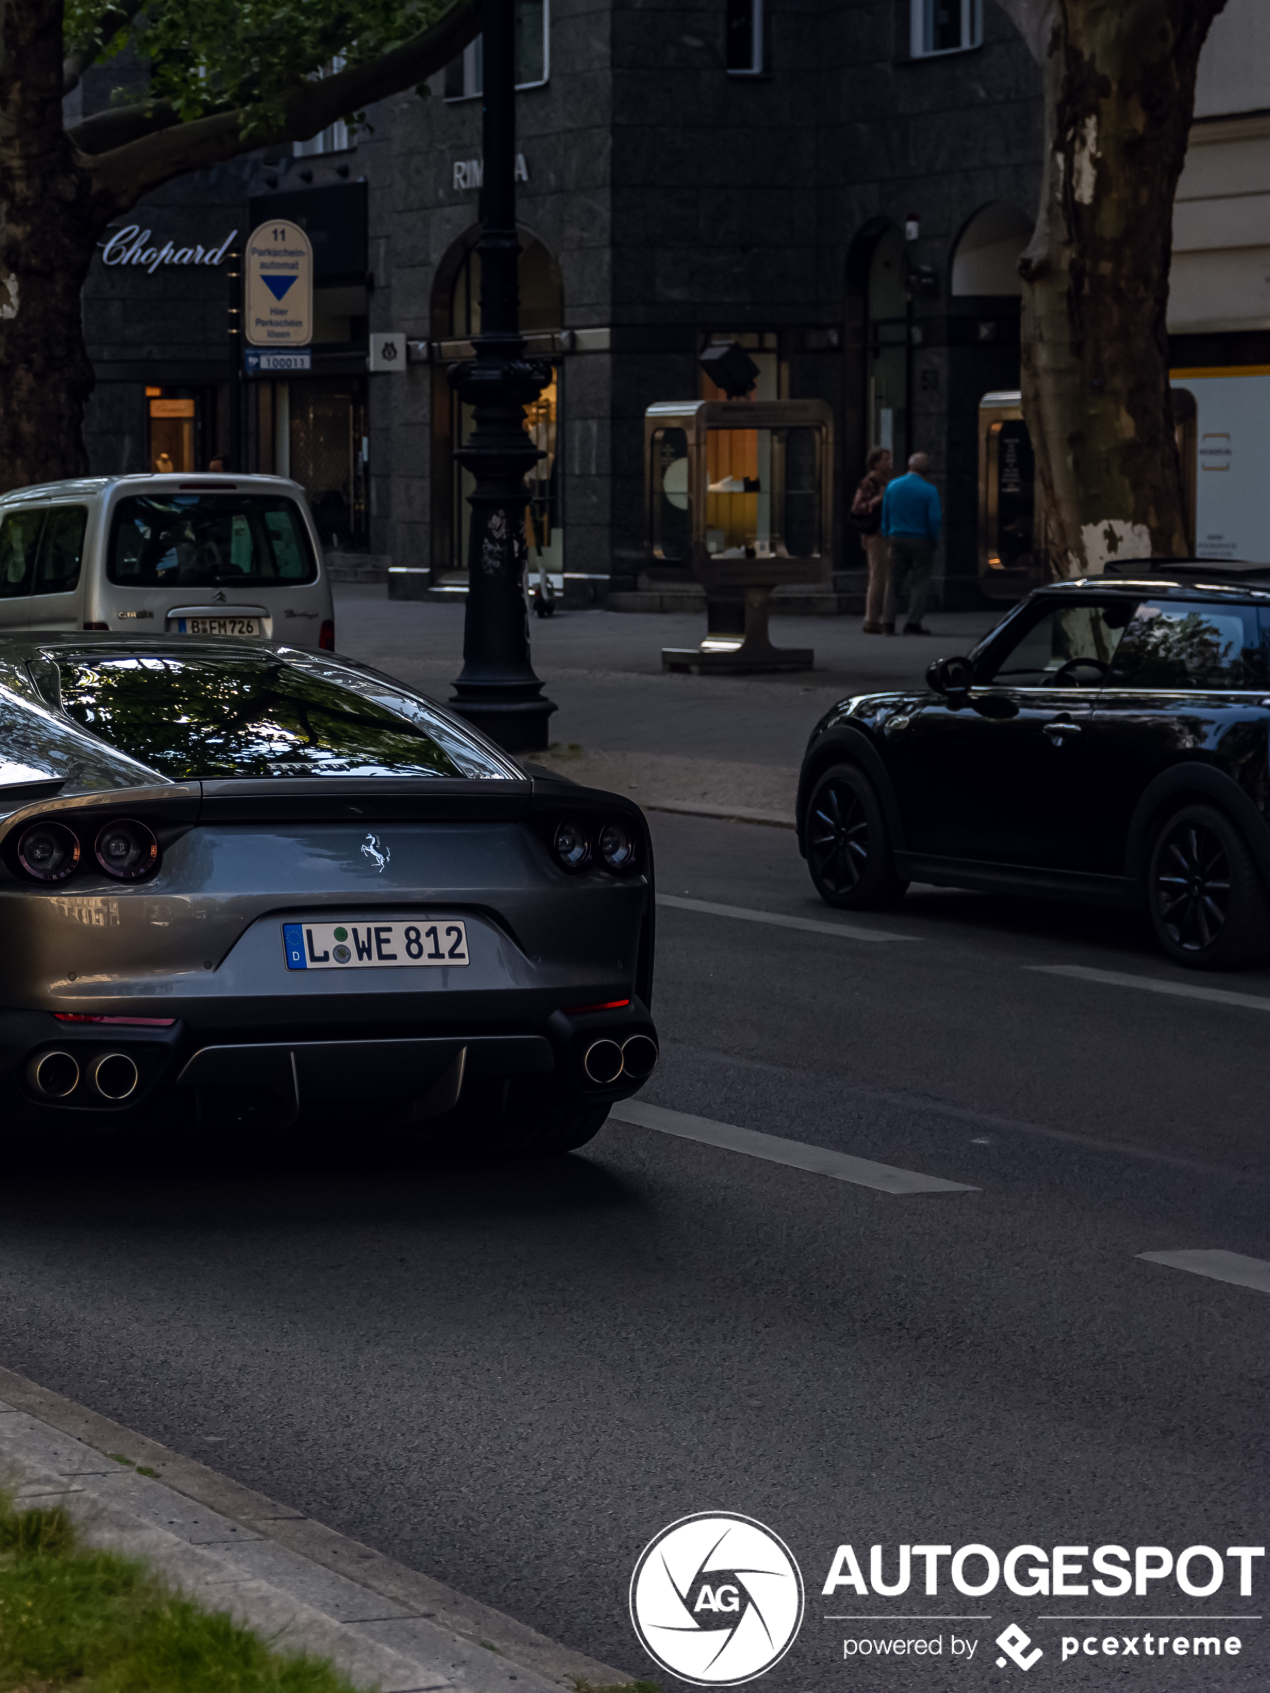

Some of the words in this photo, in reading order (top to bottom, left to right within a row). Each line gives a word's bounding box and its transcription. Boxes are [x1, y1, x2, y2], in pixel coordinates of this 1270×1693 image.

[272, 228, 286, 241] 11
[96, 223, 239, 274] Chopard
[260, 261, 299, 270] automat
[270, 307, 288, 316] Hier
[255, 318, 303, 327] Parkschein
[266, 358, 305, 368] 100011
[191, 620, 200, 634] B
[210, 620, 227, 634] FM
[229, 620, 254, 634] 726
[306, 929, 329, 962] L
[352, 926, 397, 961] WE
[404, 926, 466, 959] 812
[292, 951, 300, 961] D
